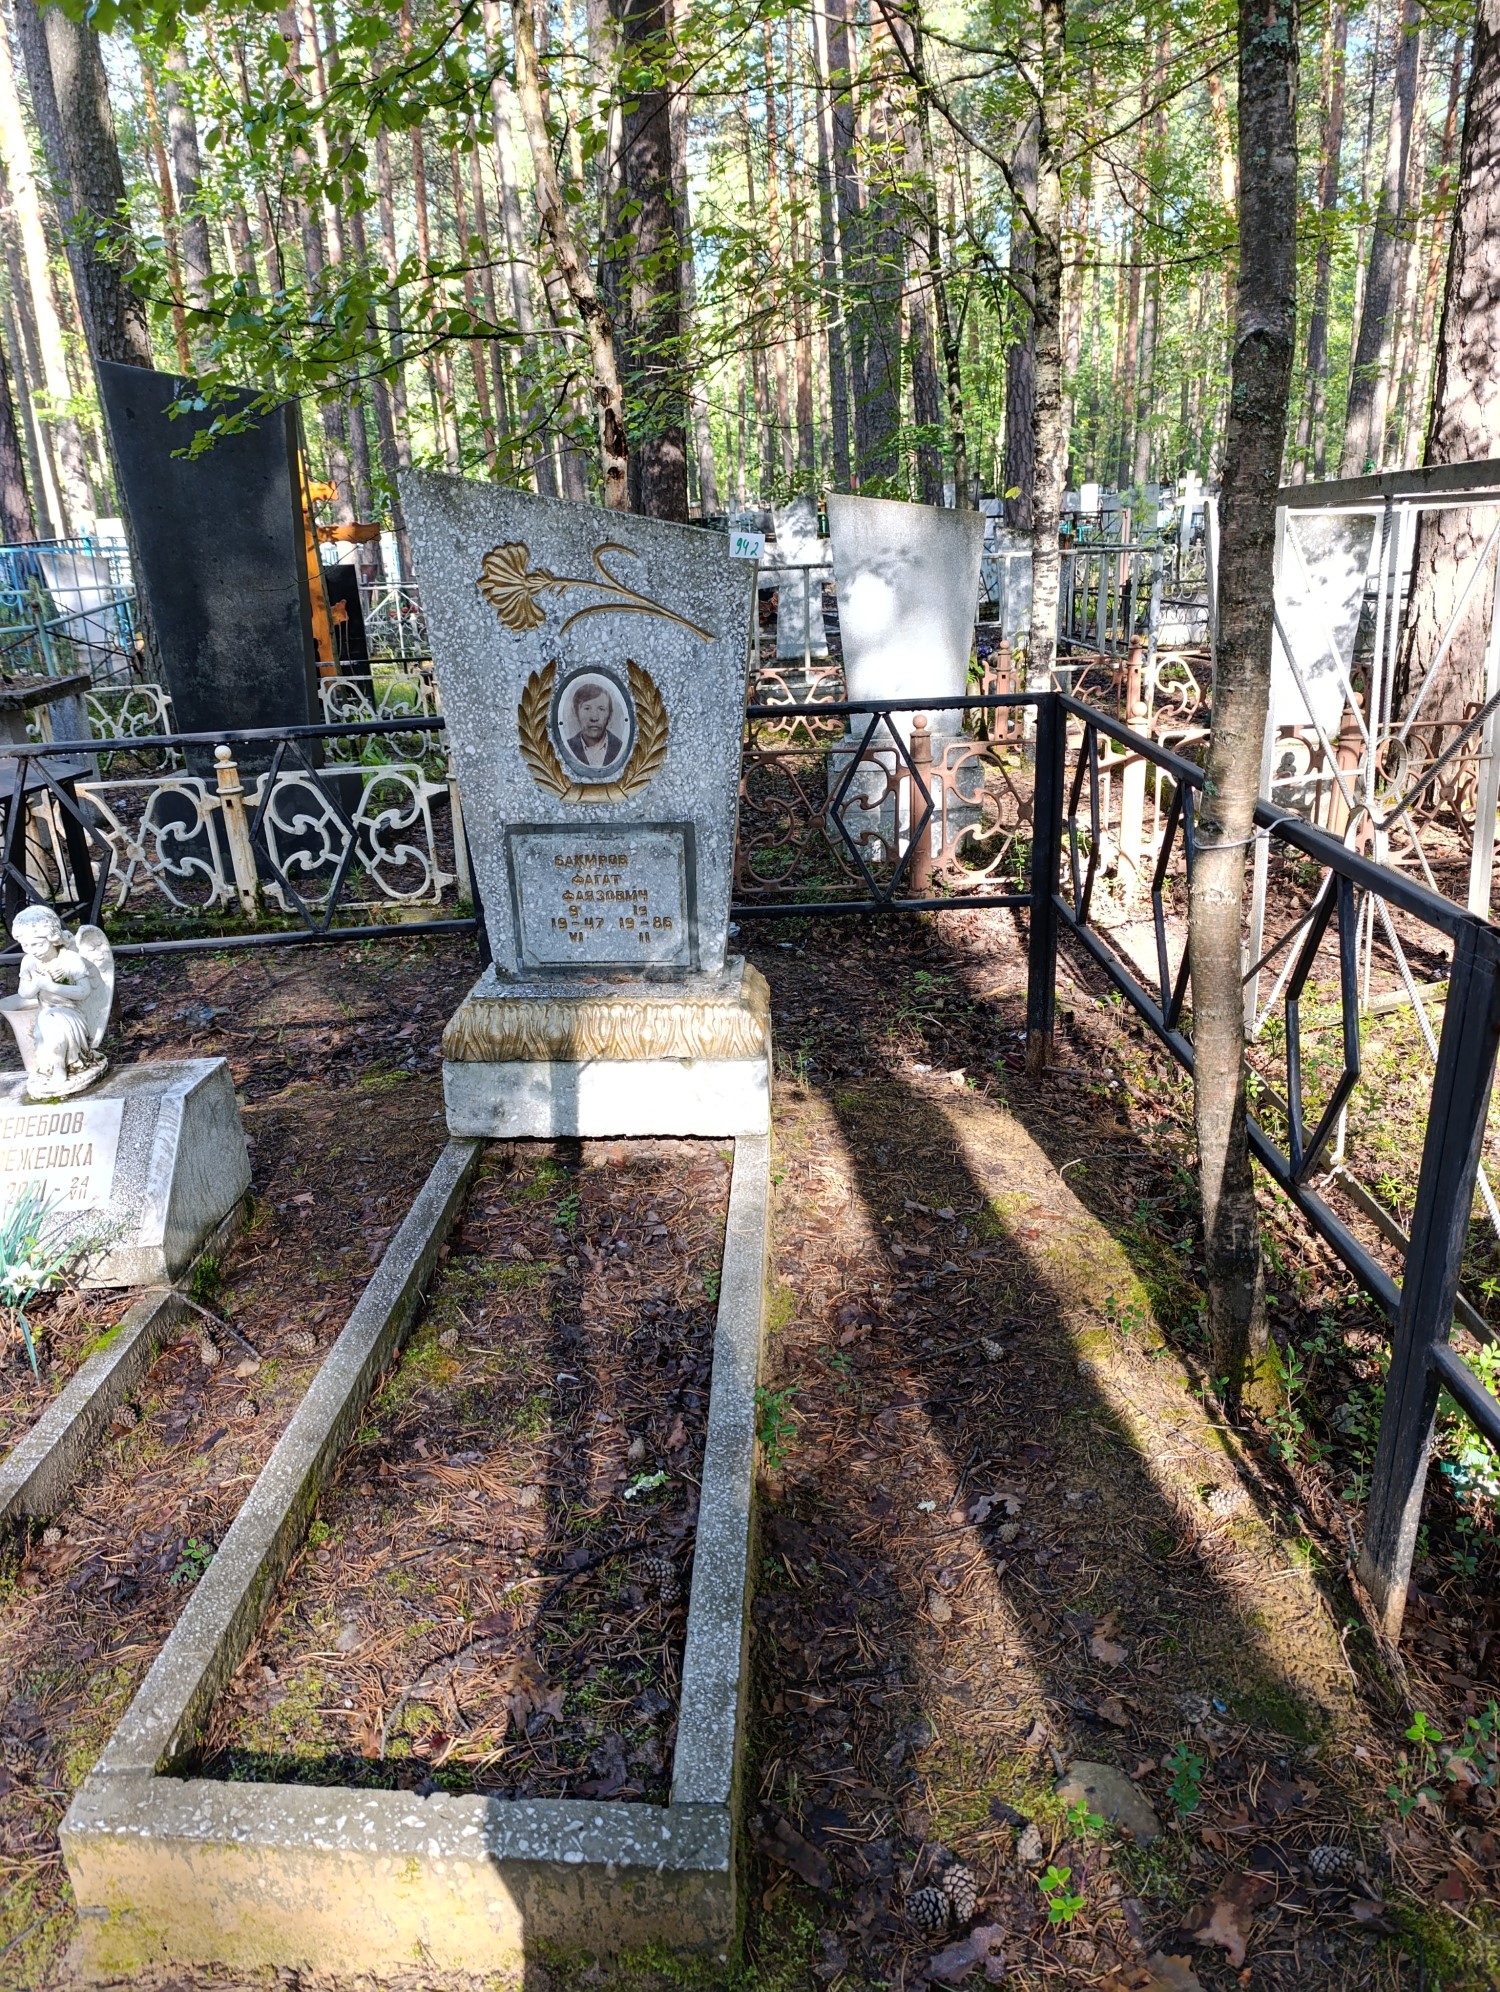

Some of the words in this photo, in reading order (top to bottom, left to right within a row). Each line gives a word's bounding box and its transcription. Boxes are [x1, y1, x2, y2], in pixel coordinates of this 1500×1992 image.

[735, 537, 759, 556] 942
[554, 854, 629, 868] БАКИРОВ
[571, 873, 622, 886] ФАГАТ
[562, 889, 649, 902] ФАЯЗОВИЧ
[0, 1111, 85, 1139] ЕРЕБРОВ
[70, 1175, 90, 1188] 24
